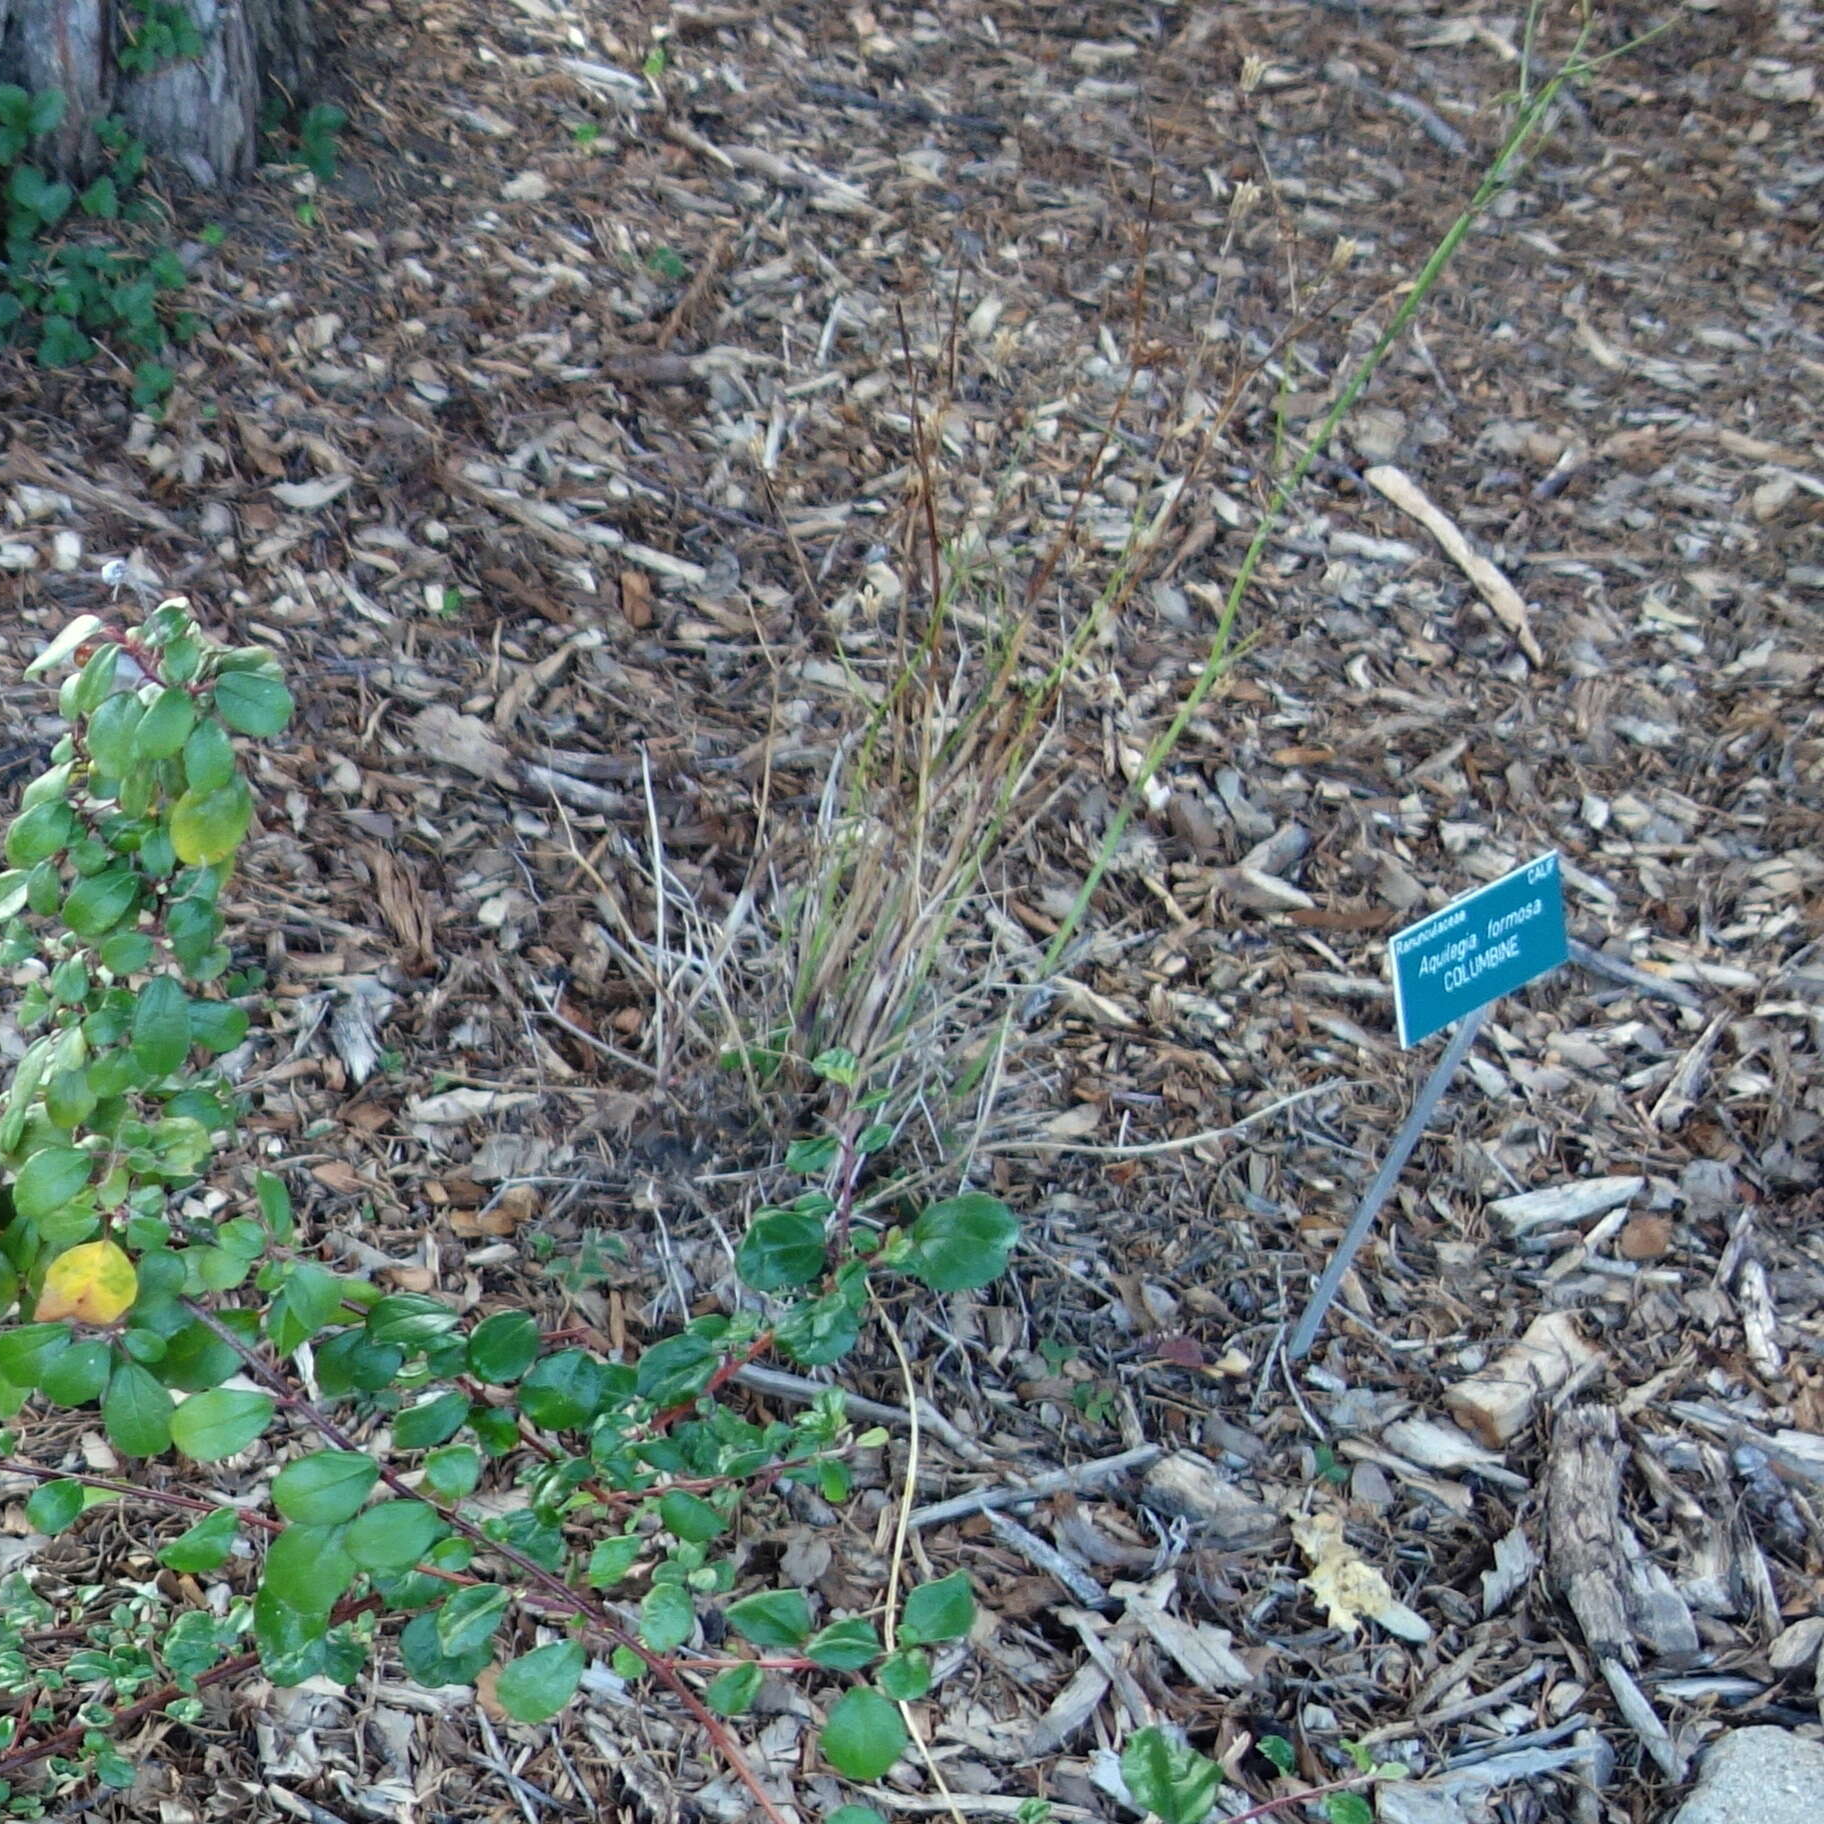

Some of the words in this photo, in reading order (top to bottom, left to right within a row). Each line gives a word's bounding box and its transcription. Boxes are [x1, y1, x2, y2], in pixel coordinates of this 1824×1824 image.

[1418, 931, 1478, 978] Aquilegia
[1487, 898, 1543, 940] formosa
[1443, 934, 1521, 993] COLUMBINE
